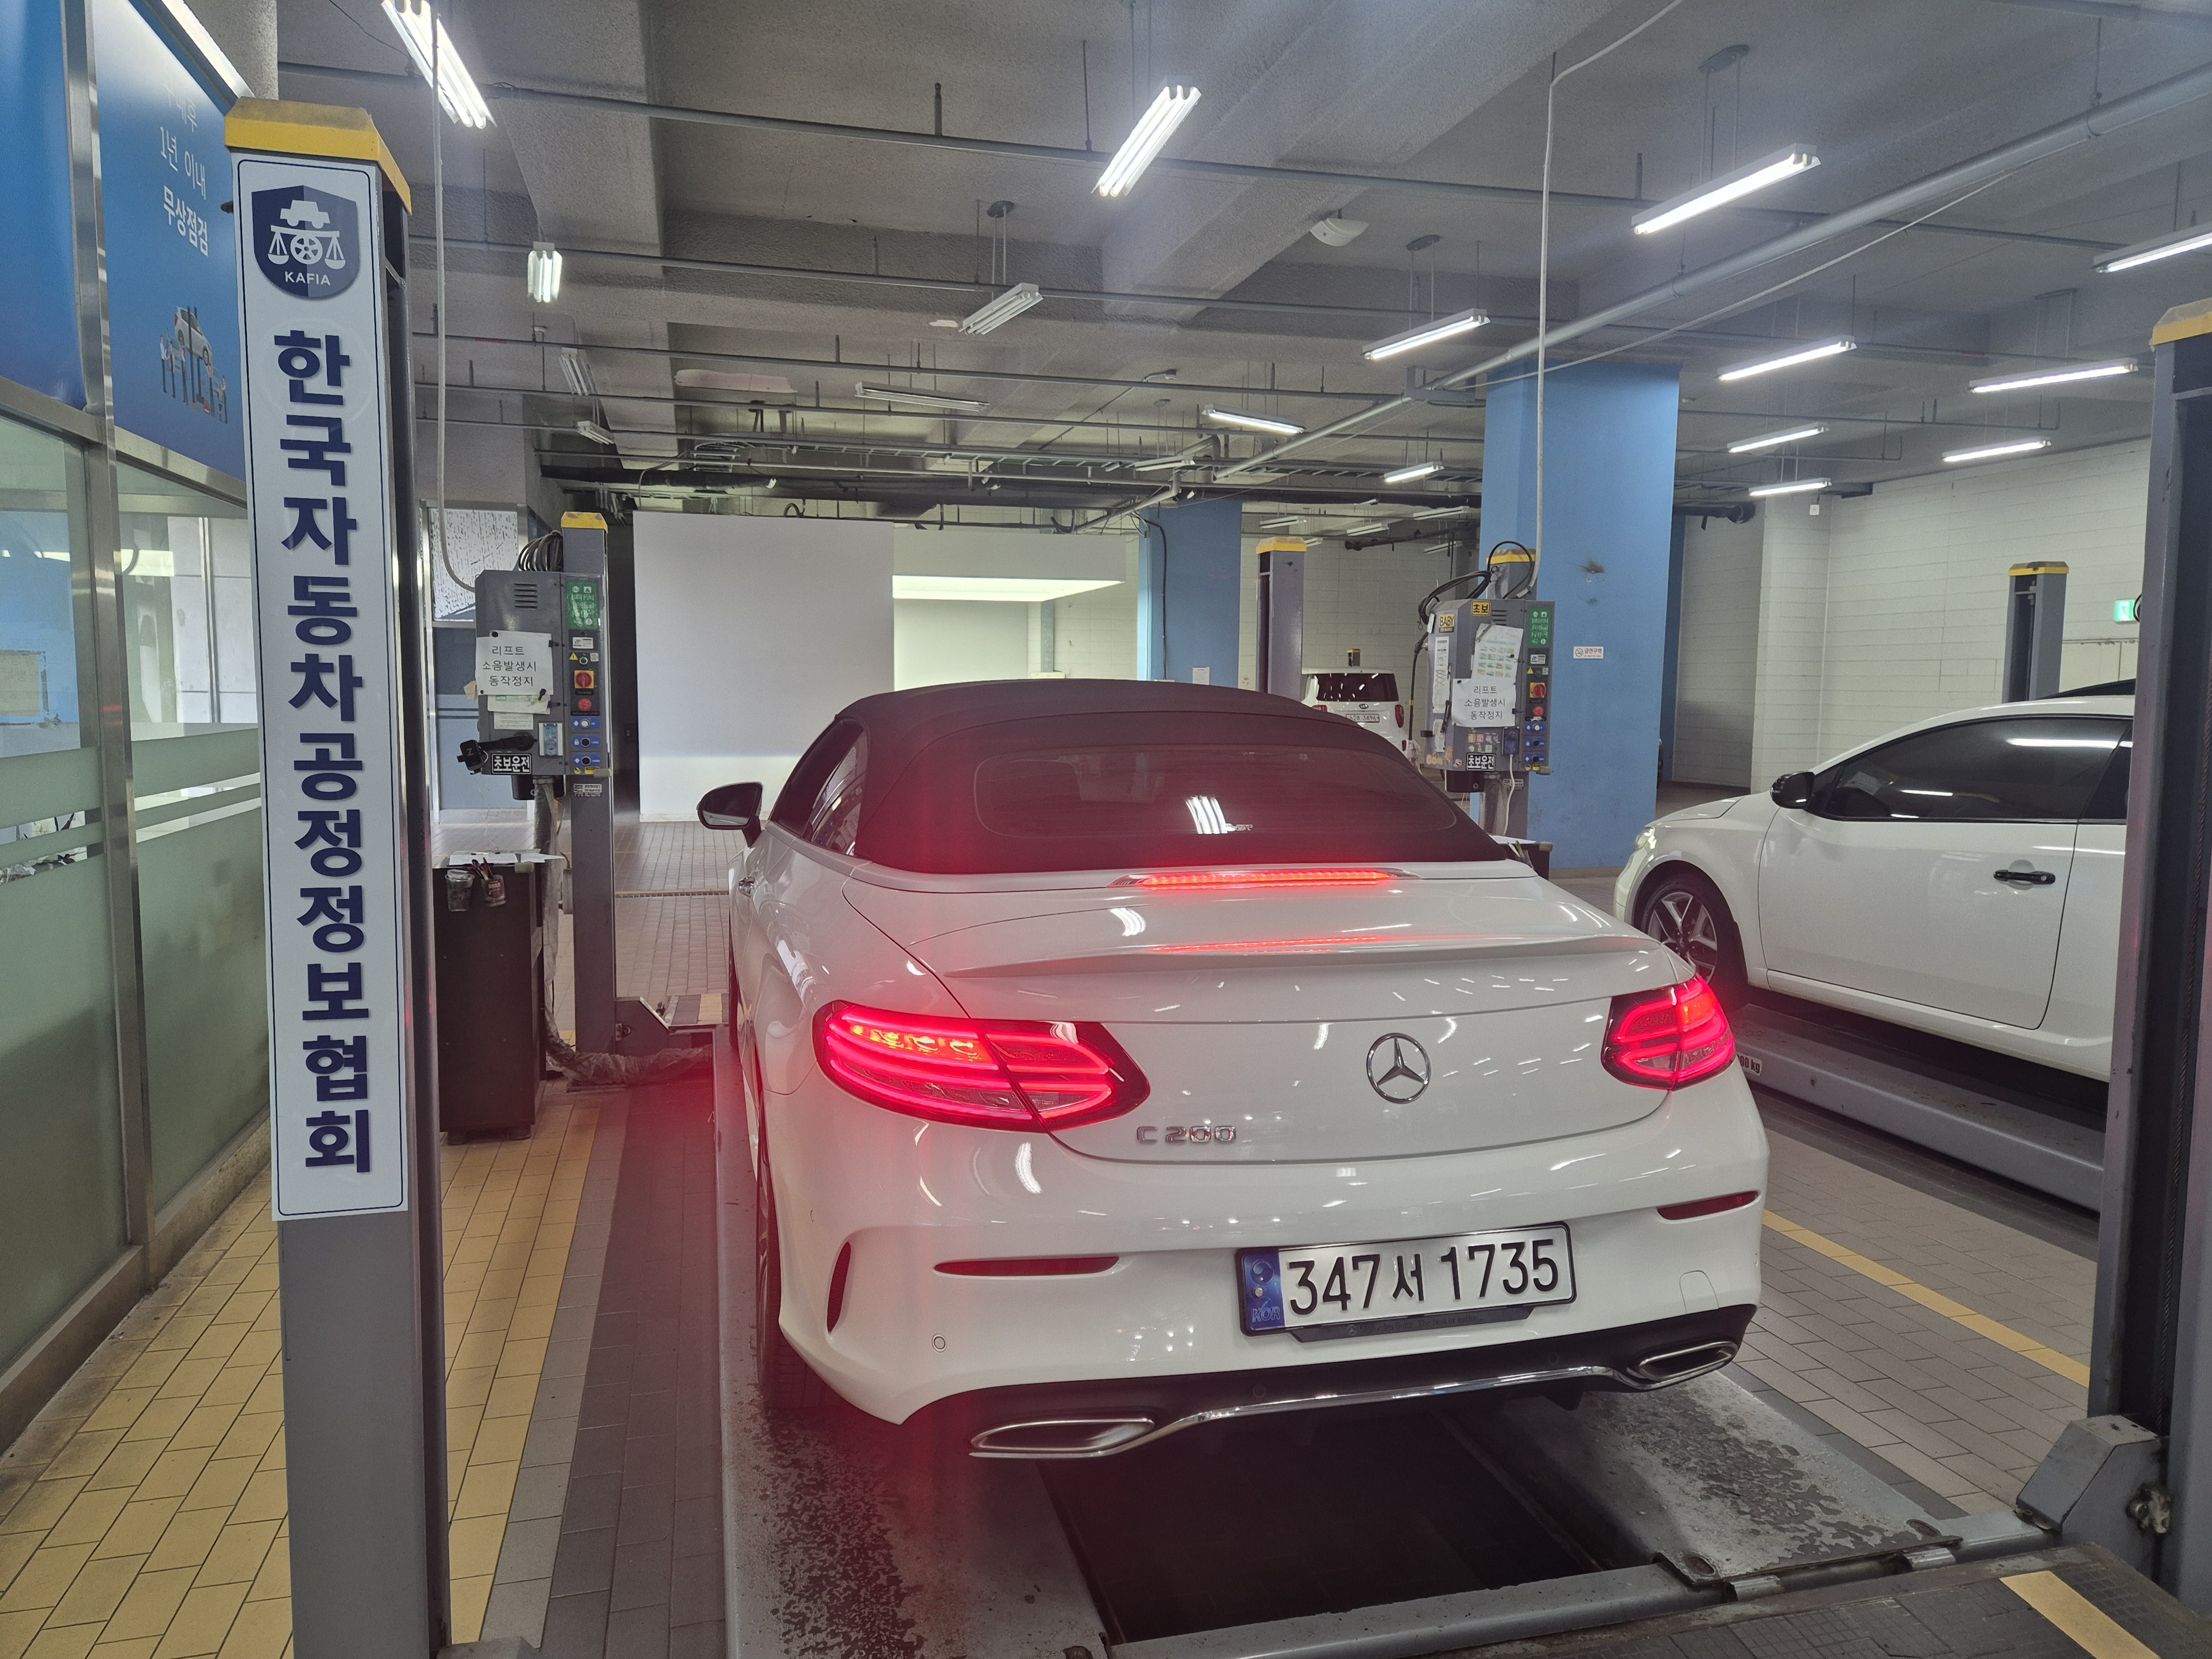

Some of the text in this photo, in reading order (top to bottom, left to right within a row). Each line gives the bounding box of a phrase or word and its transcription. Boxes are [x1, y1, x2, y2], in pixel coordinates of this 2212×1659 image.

[160, 126, 206, 200] 1년 이내
[163, 185, 208, 257] 무상점검
[284, 271, 331, 286] KAFIA
[1473, 603, 1488, 613] 초보
[1439, 615, 1455, 627] BABY
[492, 645, 525, 656] 리프트
[482, 660, 537, 672] 소음발생시
[489, 675, 534, 687] 동작정지
[1474, 686, 1498, 695] 리프트
[1464, 697, 1506, 708] 소음발생시
[1470, 710, 1503, 720] 동작정지
[274, 330, 370, 1173] 한국자동차공정정보협회
[493, 755, 530, 773] 초보운전
[1468, 755, 1494, 770] 초보운전
[1751, 1058, 1760, 1074] kg
[1136, 1125, 1237, 1144] C 200
[1288, 1239, 1559, 1316] 347서 1735
[1251, 1306, 1281, 1323] KOR
